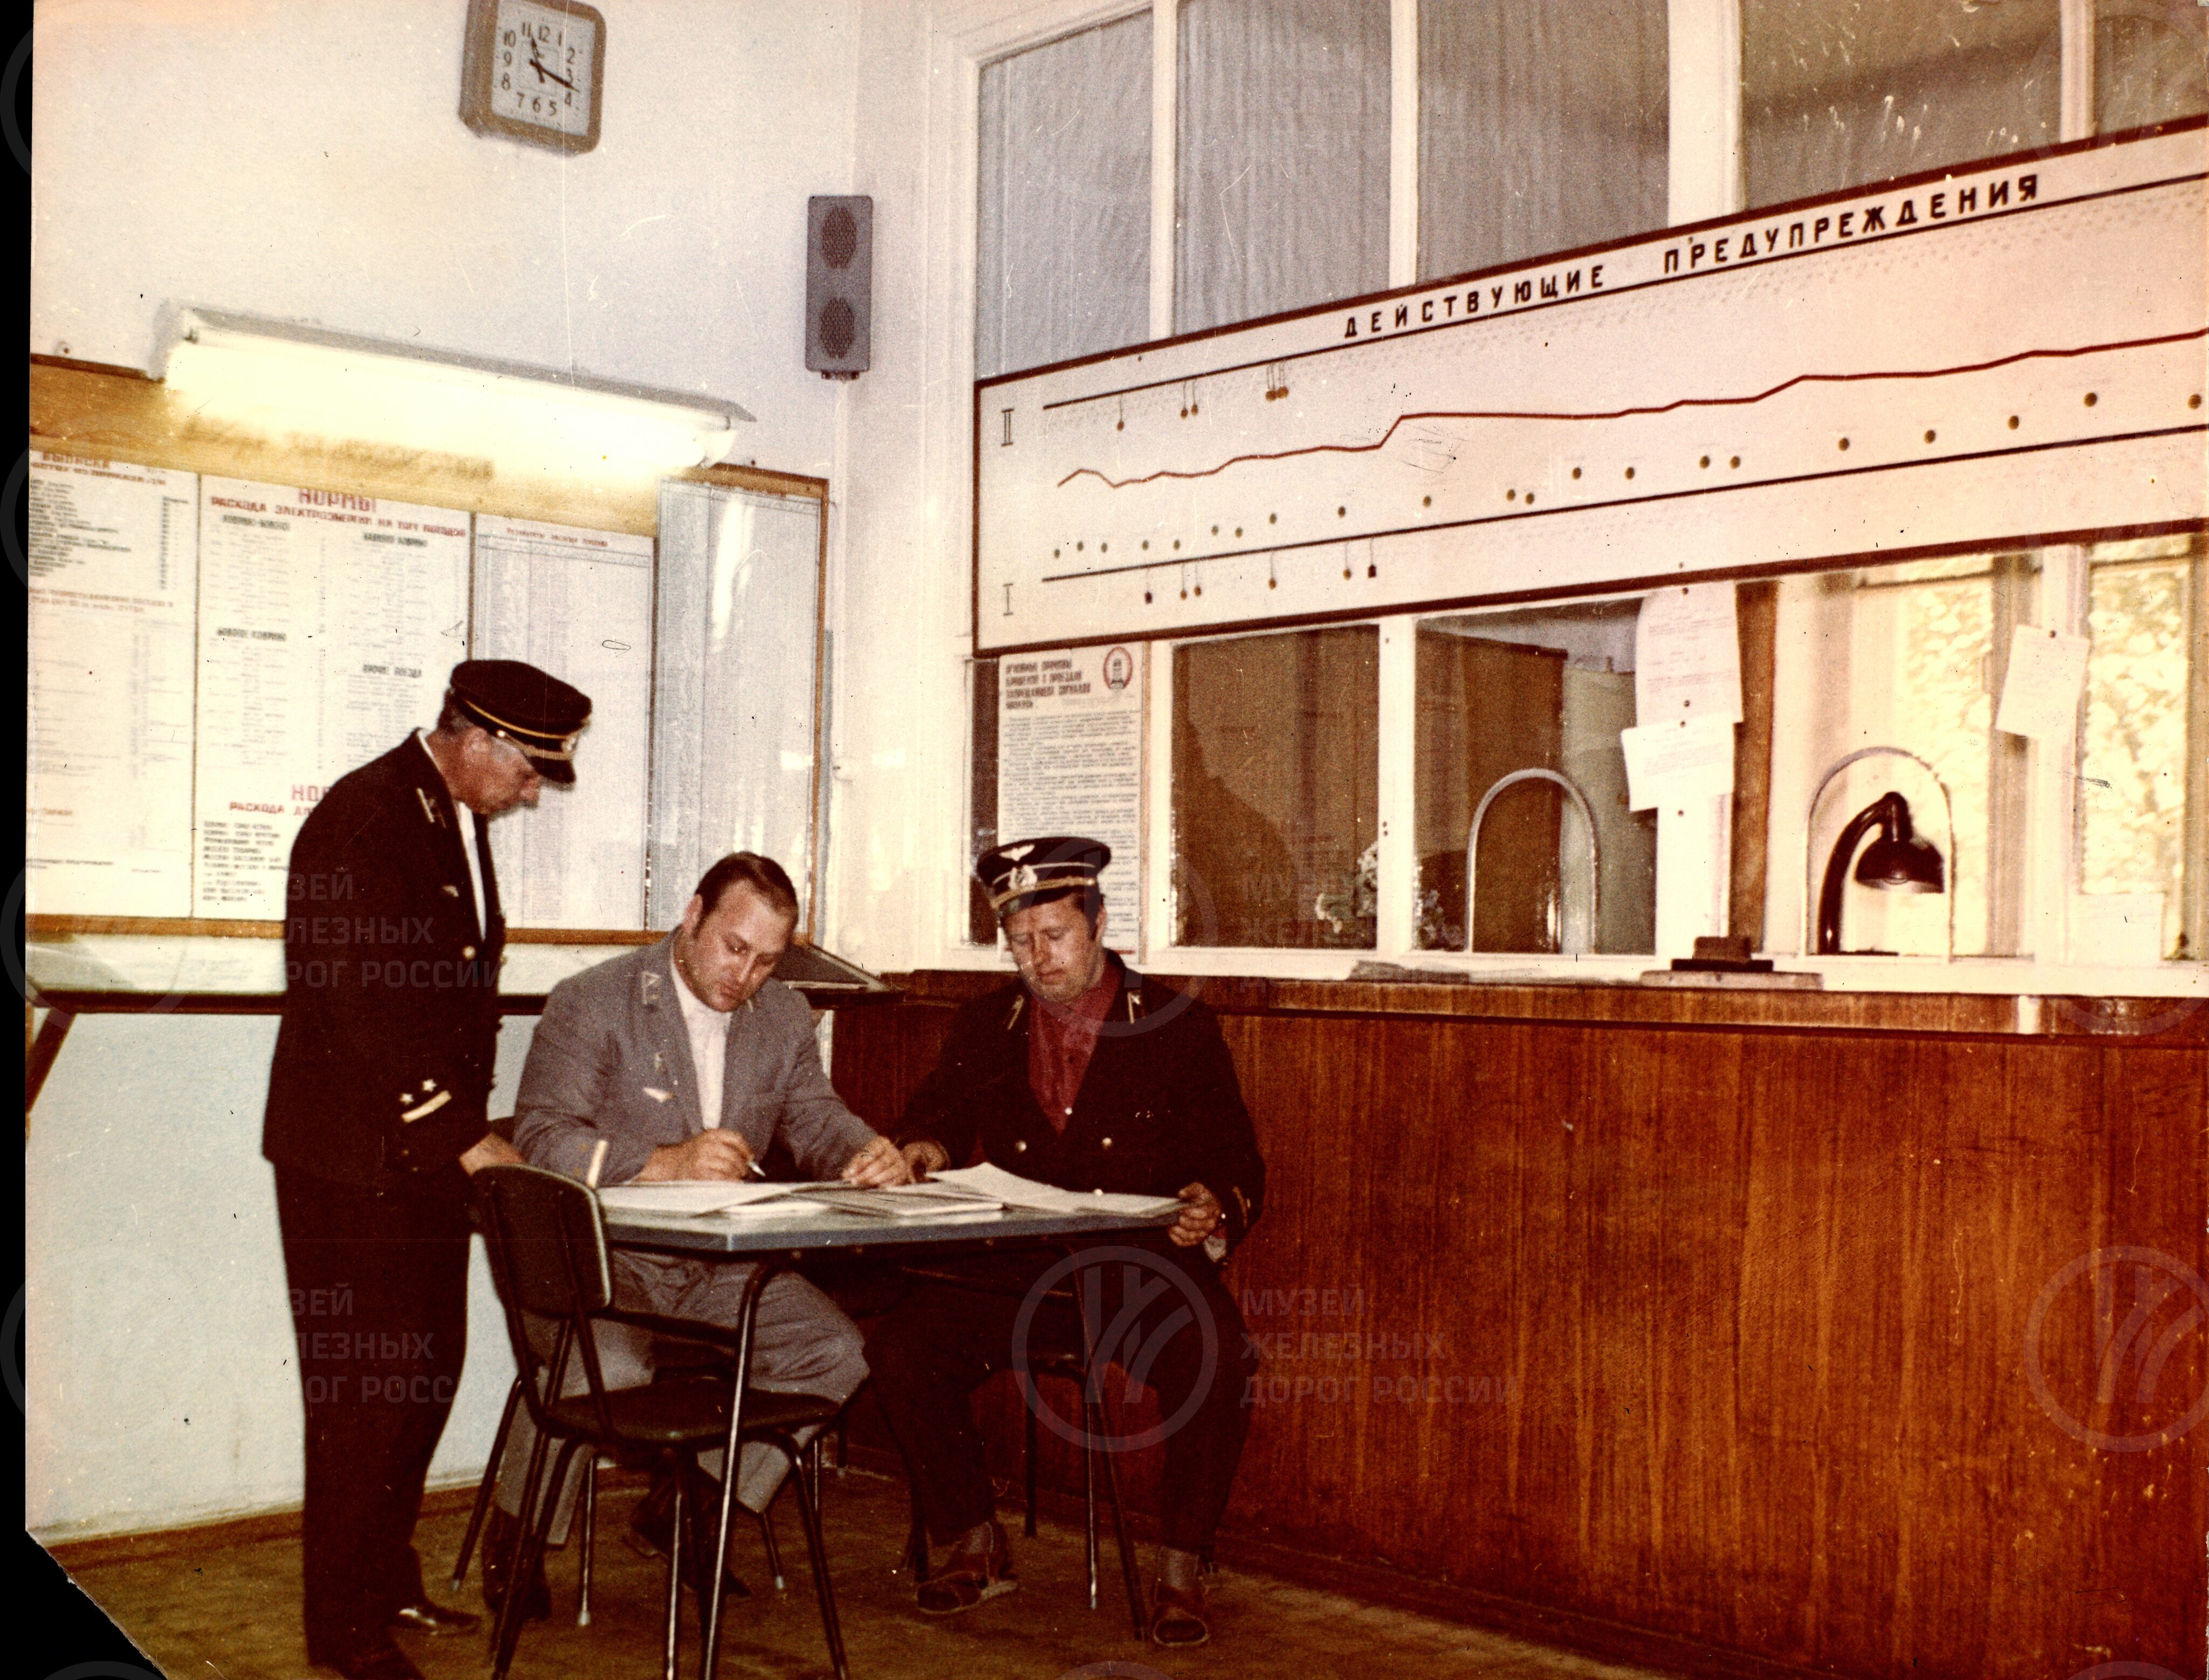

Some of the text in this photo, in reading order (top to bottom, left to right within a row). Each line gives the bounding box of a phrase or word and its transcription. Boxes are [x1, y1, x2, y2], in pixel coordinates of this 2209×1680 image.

[522, 22, 532, 38] 11
[538, 25, 551, 44] 12
[503, 30, 516, 47] 10
[558, 31, 562, 46] 1
[504, 51, 512, 67] 9
[567, 46, 575, 65] 2
[502, 72, 511, 91] 8
[567, 68, 573, 84] 3
[516, 91, 525, 108] 7
[532, 97, 541, 113] 6
[564, 92, 572, 107] 4
[549, 100, 557, 116] 5
[1344, 174, 2039, 338] ДЕЙСТВУЮЩИЕ ПРЕДУПРЕЖДЕНИЯ
